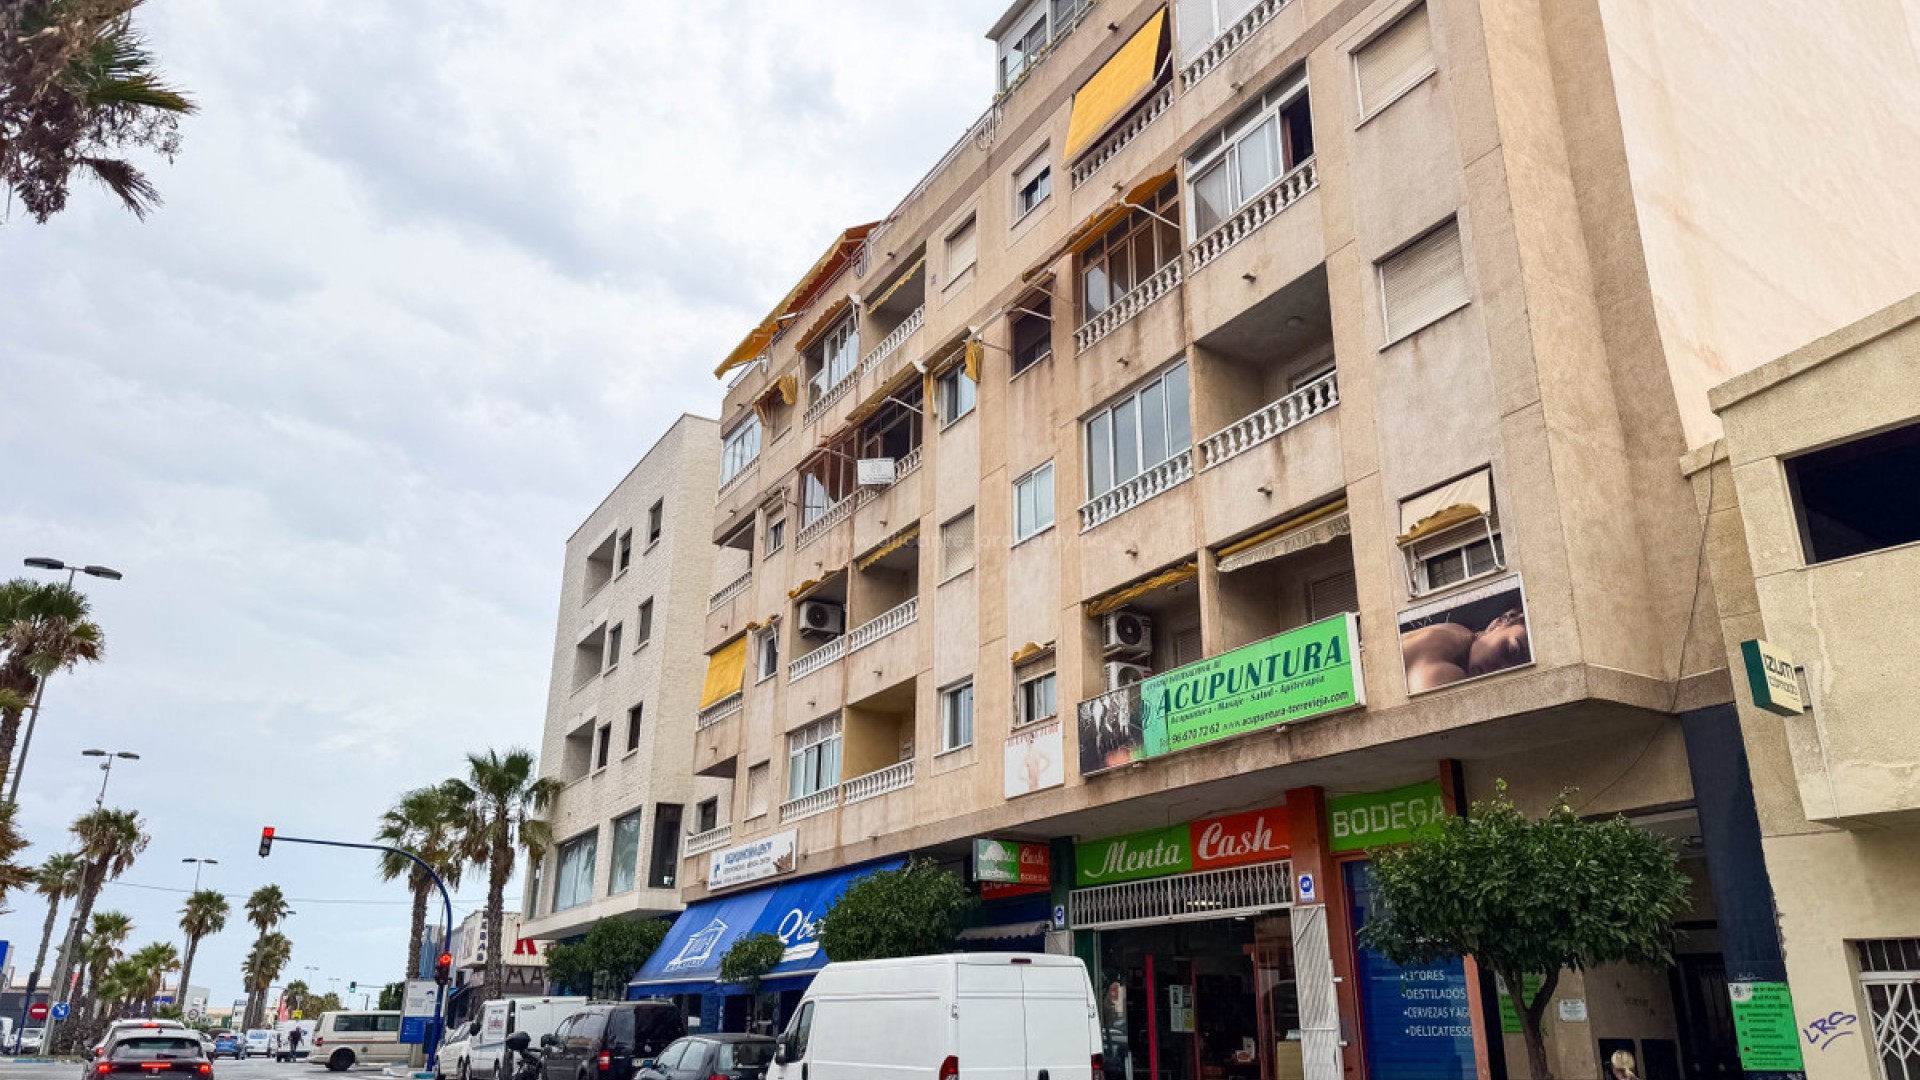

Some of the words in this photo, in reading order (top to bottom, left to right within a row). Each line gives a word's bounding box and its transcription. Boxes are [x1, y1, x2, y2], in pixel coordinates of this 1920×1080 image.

[1157, 635, 1342, 715] ACUPUNTURA
[1250, 687, 1275, 702] Salud
[1172, 731, 1182, 744] 96
[1182, 727, 1198, 742] 670
[1210, 722, 1220, 736] 62
[1222, 690, 1349, 731] www.acupuntura-torrevieja.com
[1332, 795, 1446, 838] BODEGA
[1084, 839, 1184, 878] Menta
[1197, 816, 1290, 860] Cash
[1406, 988, 1467, 1000] DESTILADOS
[1407, 1006, 1449, 1018] CERVEZAS
[1449, 1007, 1456, 1018] Y
